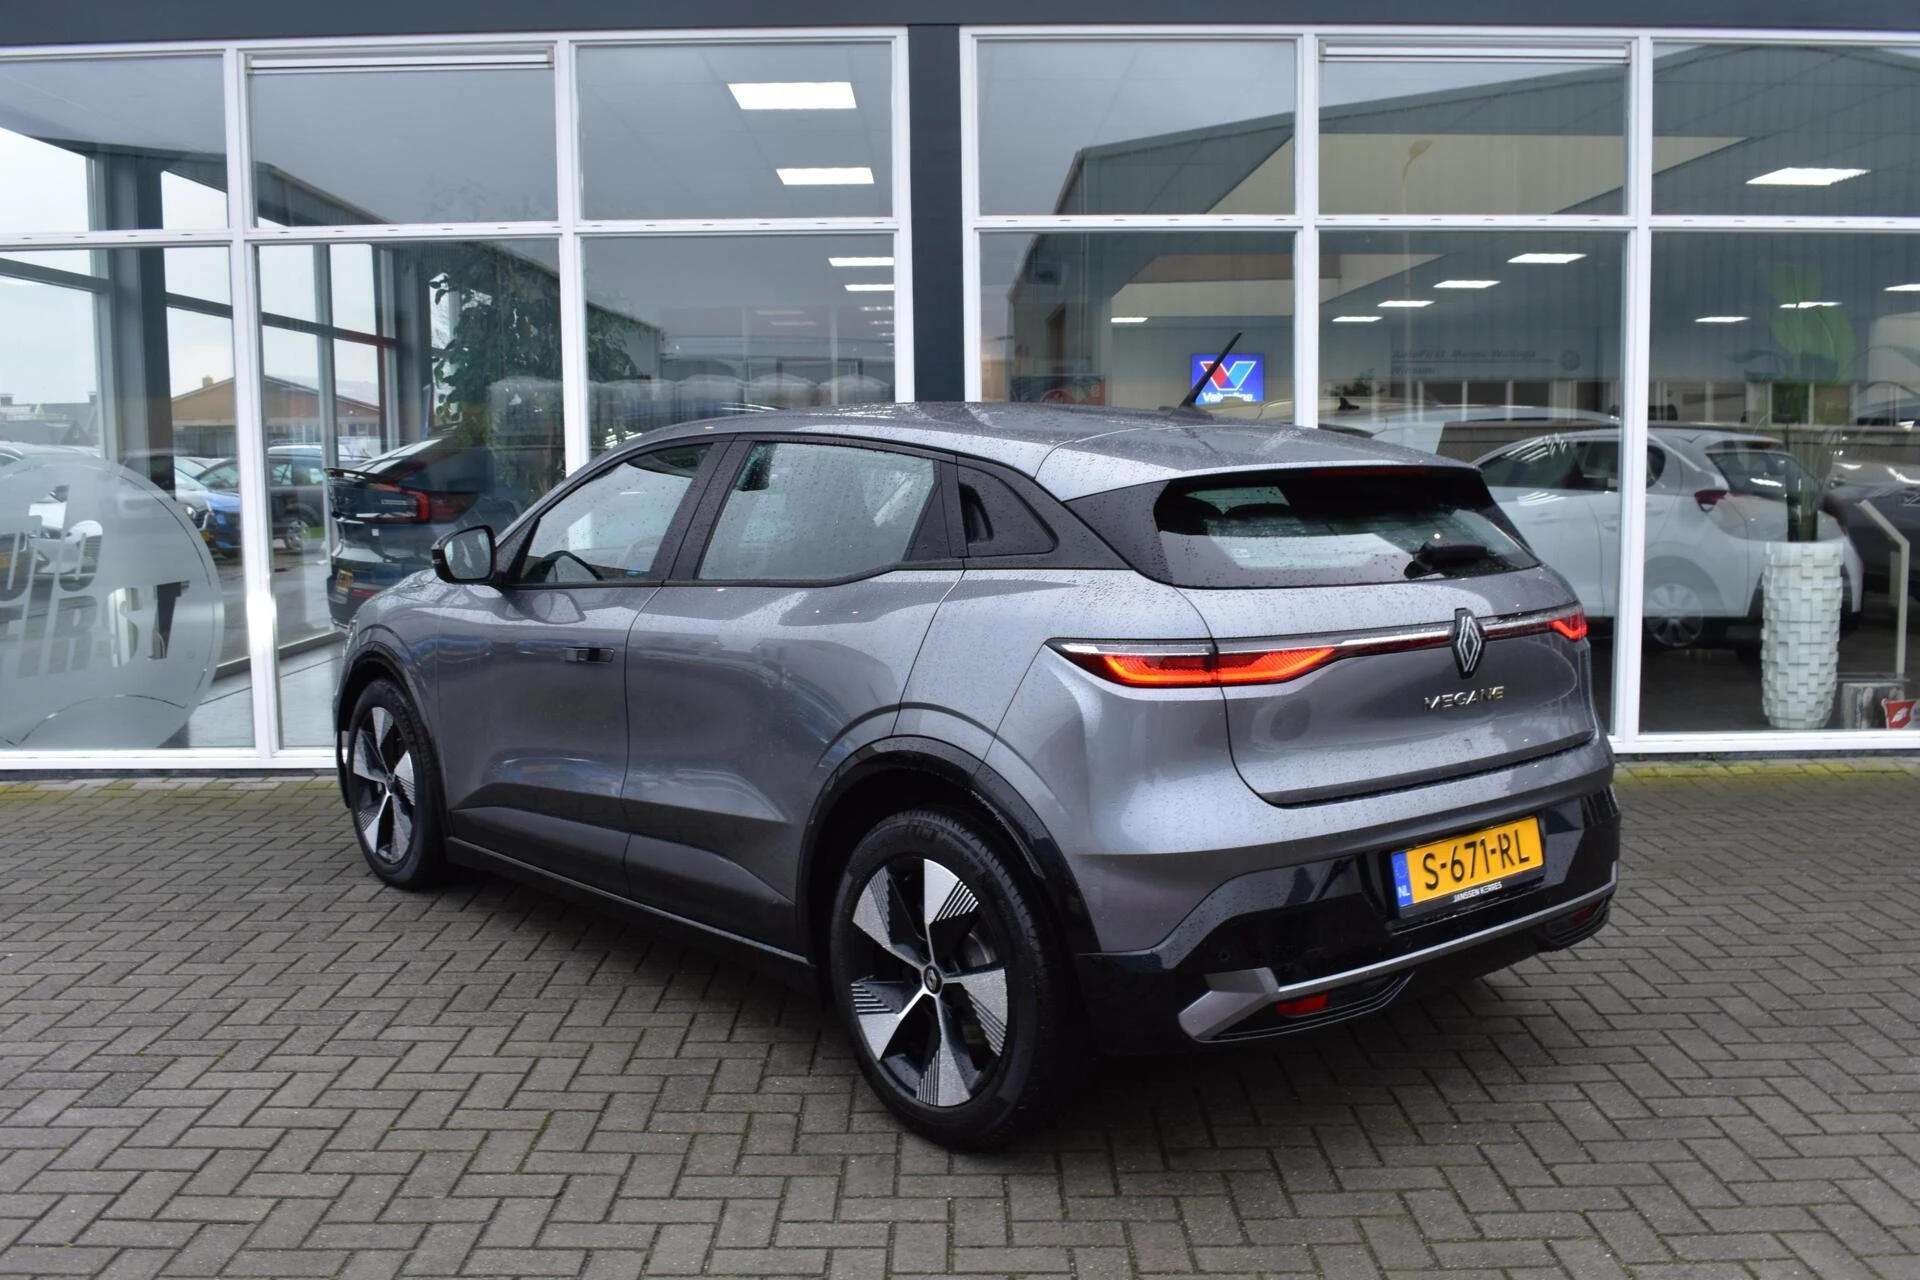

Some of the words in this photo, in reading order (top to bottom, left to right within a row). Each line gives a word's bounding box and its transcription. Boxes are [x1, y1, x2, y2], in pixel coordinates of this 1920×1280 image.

[1423, 685, 1505, 711] MEGANE
[1421, 829, 1530, 890] S-671-RL
[1397, 884, 1411, 898] NL
[1452, 888, 1480, 903] JANSSEN
